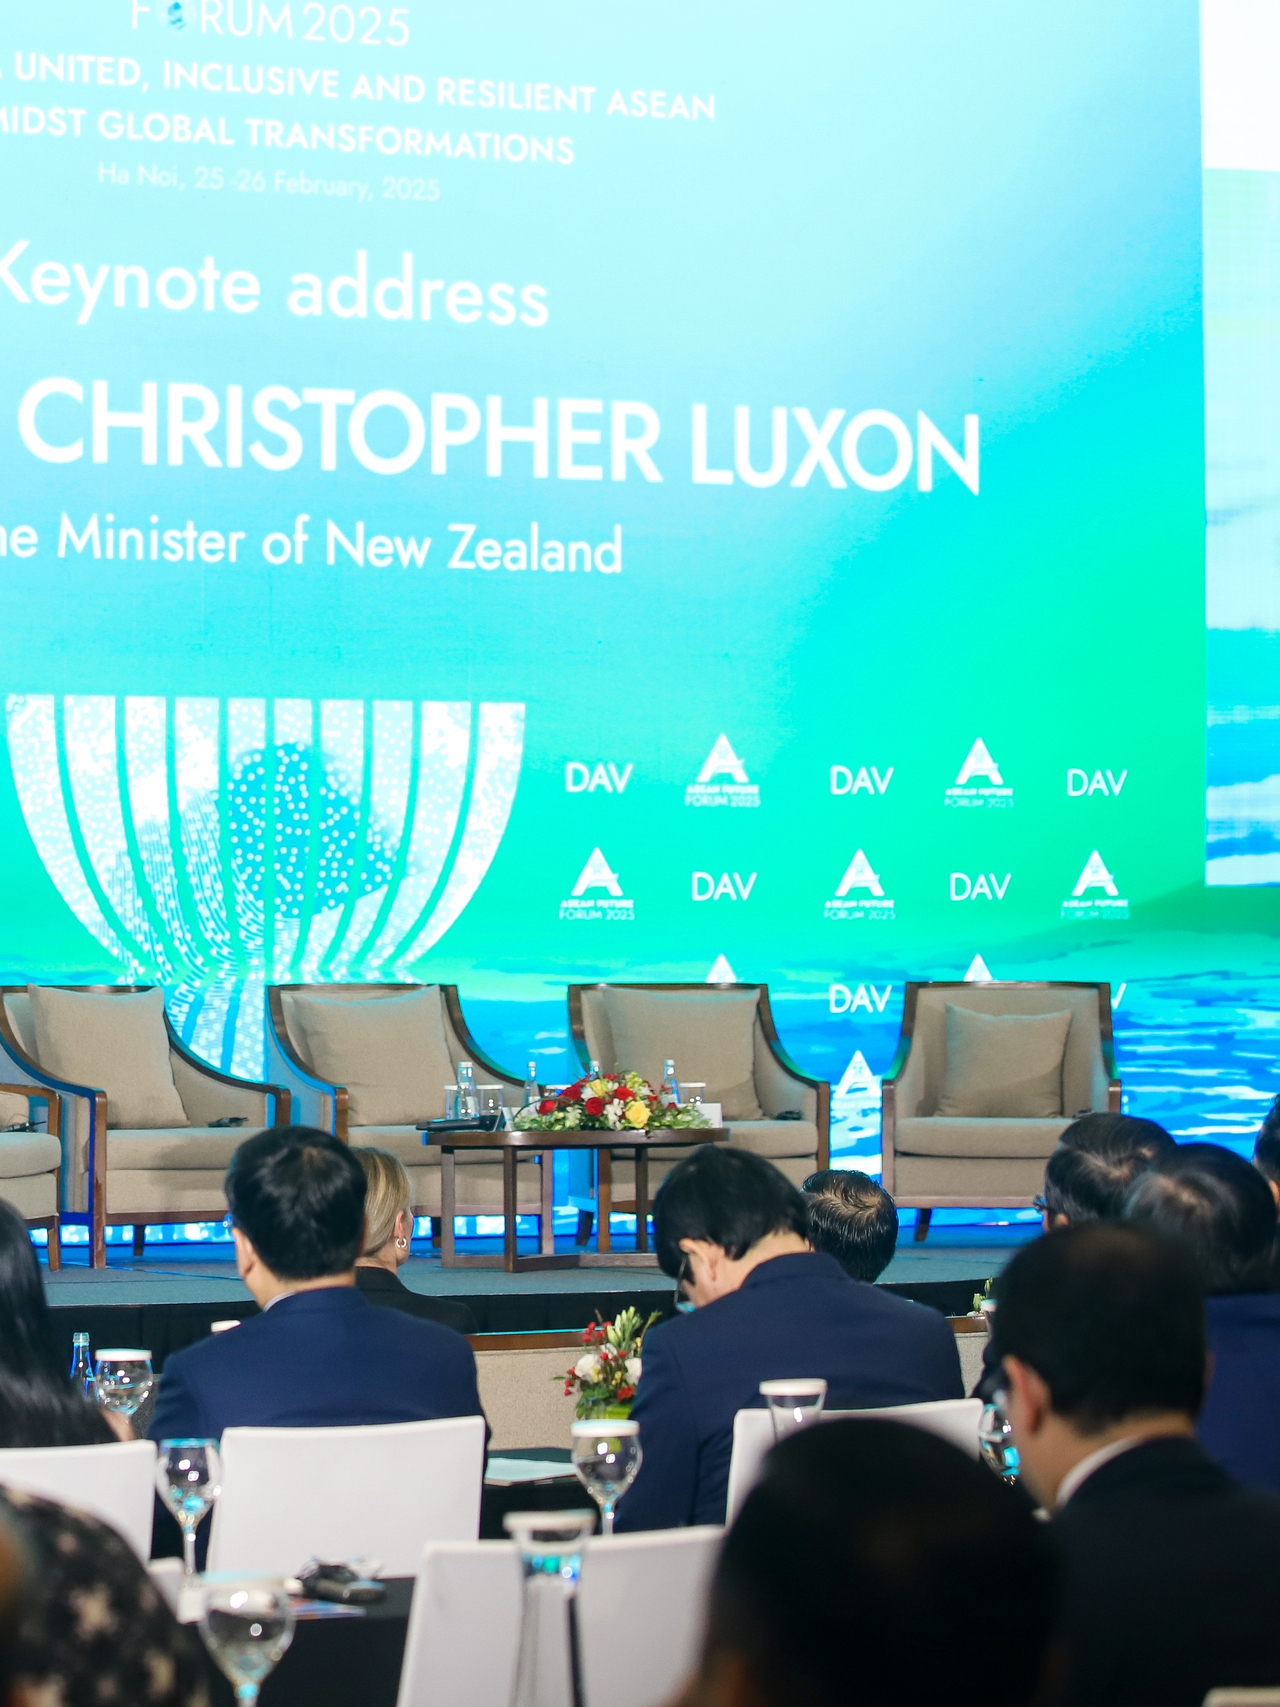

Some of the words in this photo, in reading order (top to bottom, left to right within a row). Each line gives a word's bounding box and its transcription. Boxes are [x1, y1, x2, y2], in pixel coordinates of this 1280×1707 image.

[302, 2, 410, 46] 2025
[14, 51, 150, 93] UNITED,
[163, 60, 340, 99] INCLUSIVE
[351, 73, 426, 104] AND
[437, 77, 596, 115] RESILIENT
[606, 89, 716, 122] ASEAN
[97, 109, 235, 147] GLOBAL
[245, 118, 575, 165] TRANSFORMATIONS
[98, 161, 130, 186] Ha
[138, 164, 186, 192] Noi,
[195, 167, 224, 190] 25
[274, 171, 374, 203] February,
[382, 177, 441, 202] 2025
[287, 249, 550, 327] address
[17, 377, 664, 484] CHRISTOPHER
[691, 403, 980, 496] LUXON
[56, 511, 246, 563] Minister
[261, 514, 311, 565] of
[325, 518, 432, 568] New
[447, 521, 622, 574] Zealand
[565, 761, 634, 794] DAV
[830, 764, 894, 795] DAV
[1067, 768, 1128, 796] DAV
[691, 871, 758, 901] DAV
[949, 872, 1012, 901] DAV
[829, 984, 893, 1014] DAV
